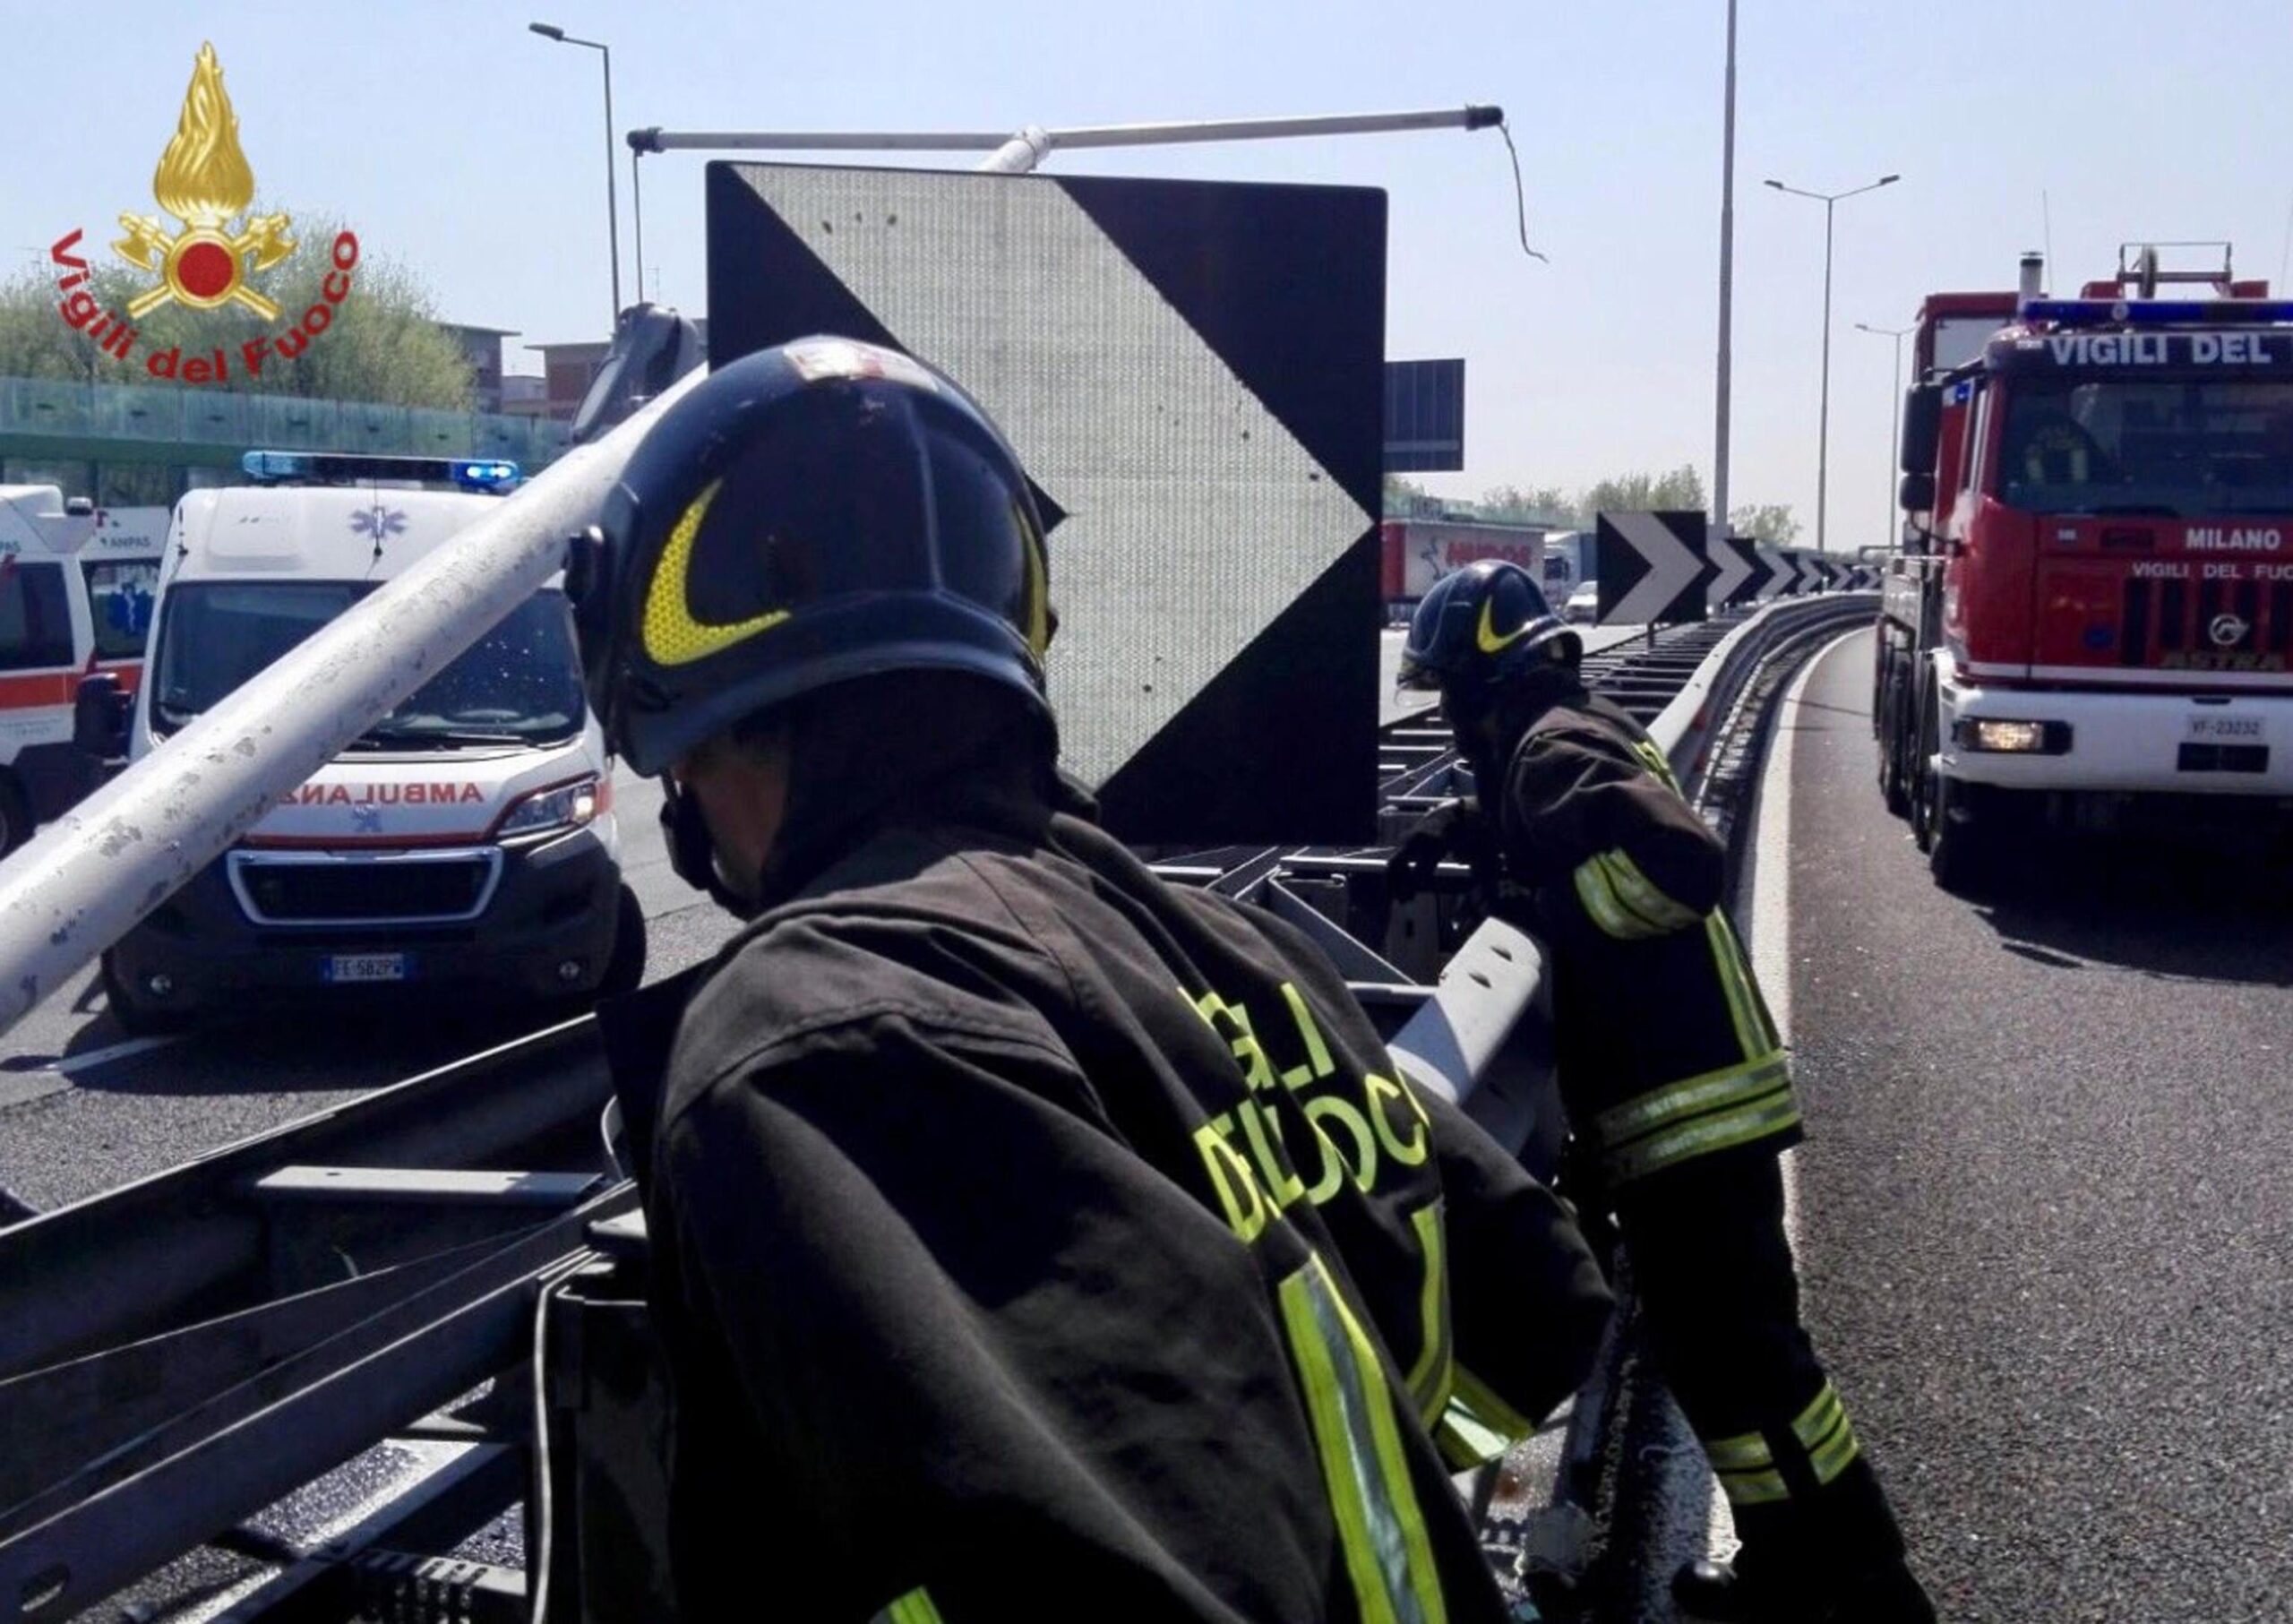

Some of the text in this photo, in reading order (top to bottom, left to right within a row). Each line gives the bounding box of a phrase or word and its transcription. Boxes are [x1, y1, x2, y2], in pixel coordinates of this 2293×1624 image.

[2048, 334, 2272, 365] VIGILI DEL
[2186, 528, 2281, 550] MILANO
[2132, 563, 2190, 578] VIGILI
[2203, 563, 2242, 579] DEL
